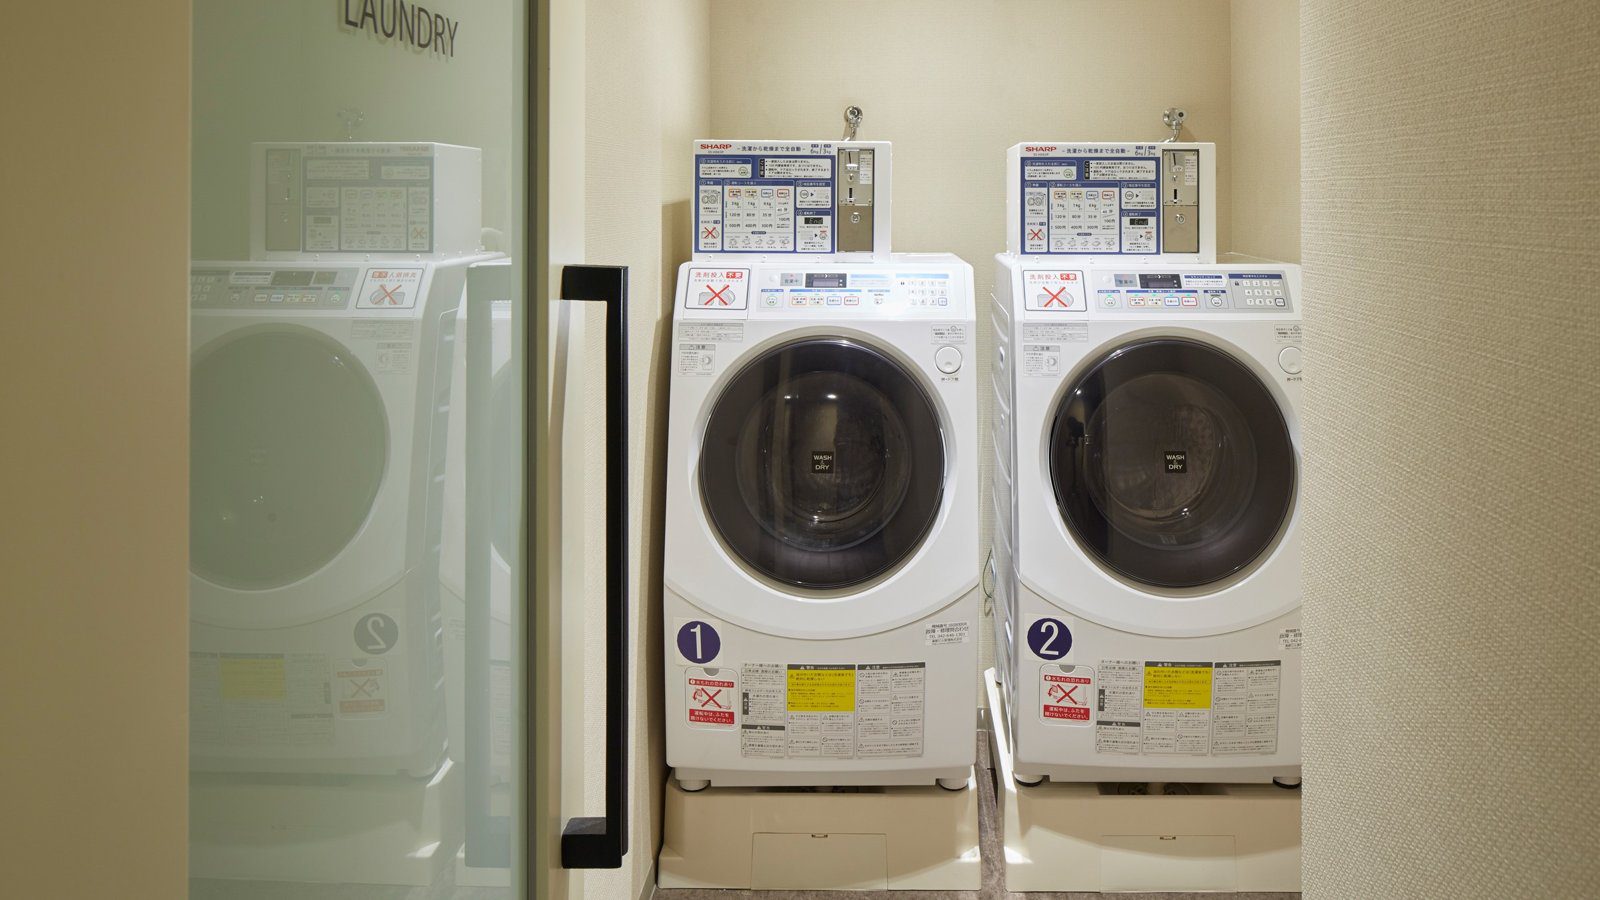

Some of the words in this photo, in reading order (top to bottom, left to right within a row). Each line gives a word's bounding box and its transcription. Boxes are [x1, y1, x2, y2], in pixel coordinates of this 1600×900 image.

[346, 0, 458, 57] LAUNDRY
[690, 624, 702, 659] 1
[1040, 621, 1059, 656] 2
